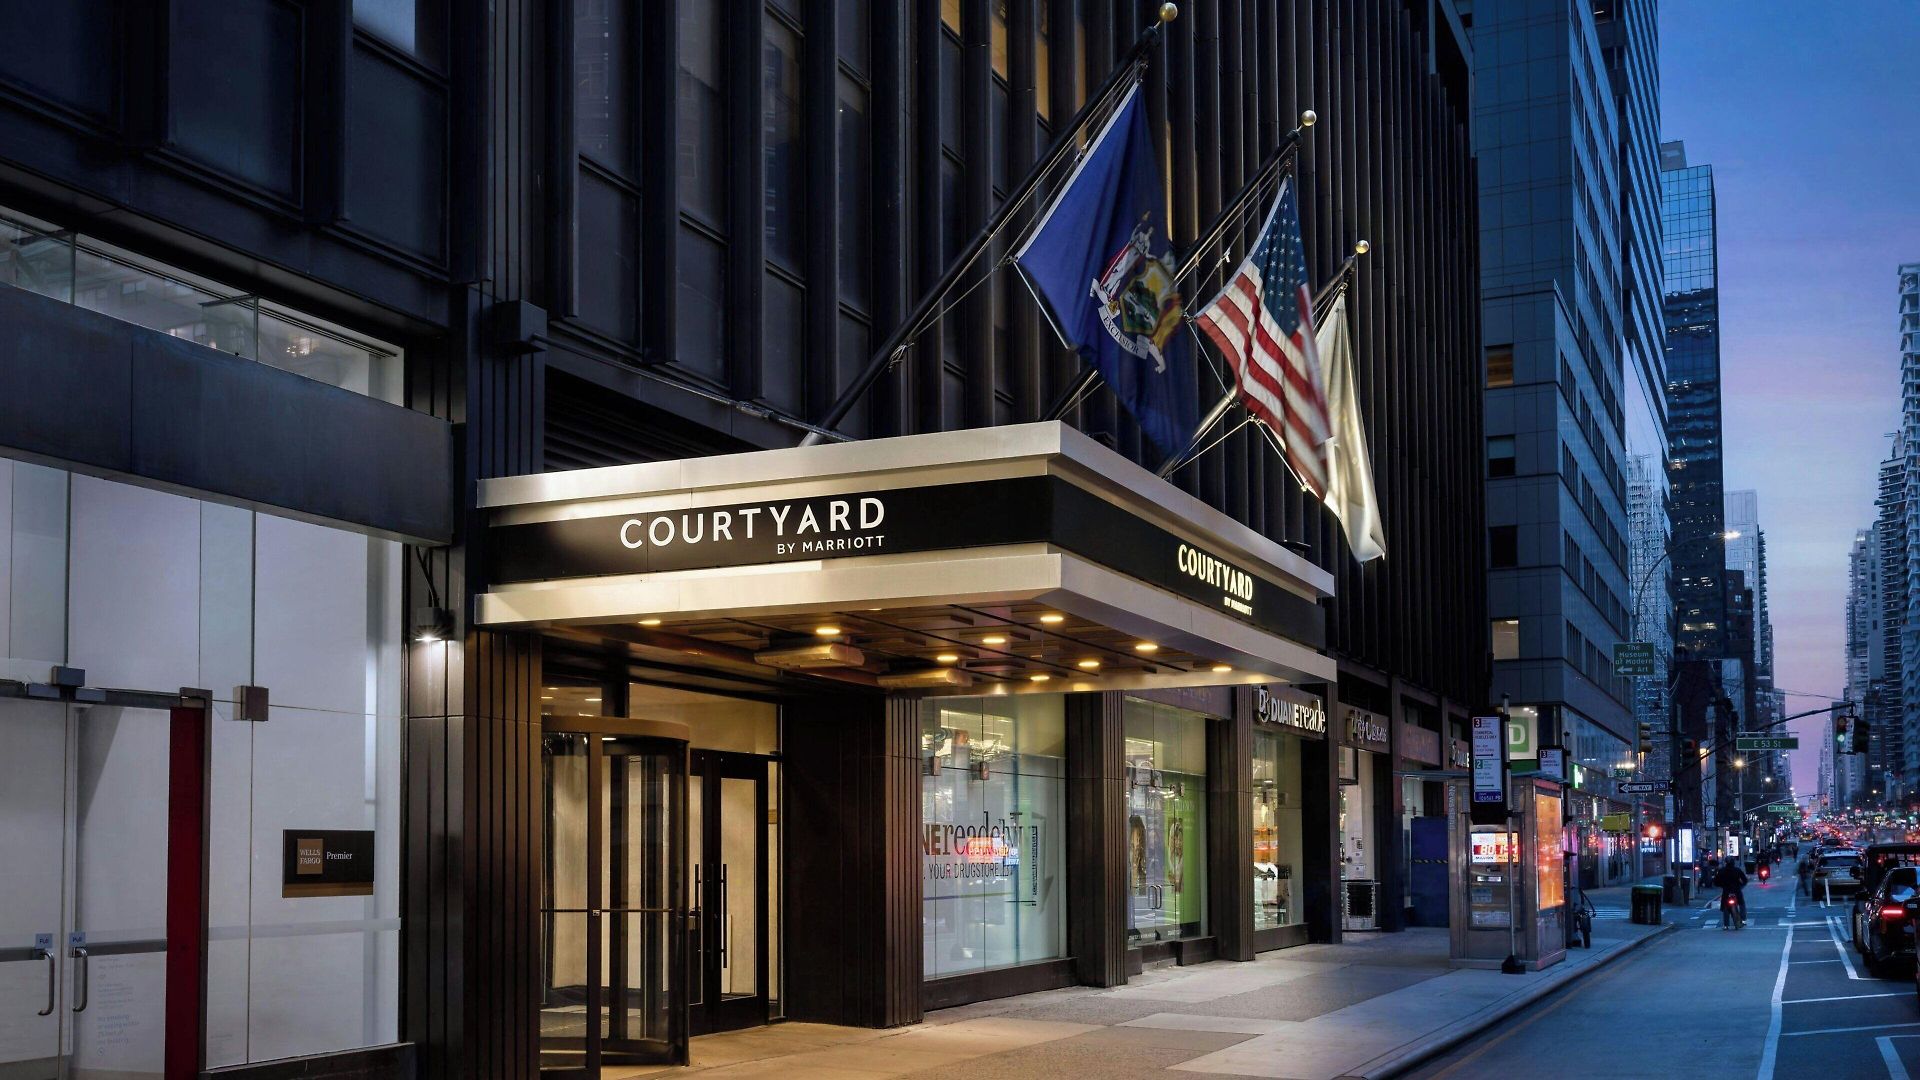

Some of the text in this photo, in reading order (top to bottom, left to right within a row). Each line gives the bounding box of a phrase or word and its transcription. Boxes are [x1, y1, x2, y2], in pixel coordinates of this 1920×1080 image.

[619, 497, 885, 549] COURTYARD
[777, 535, 885, 555] BY MARRIOTT
[1178, 544, 1253, 601] COURTYARD
[1475, 718, 1480, 727] 3
[1773, 740, 1781, 748] St
[1476, 760, 1481, 768] 2
[326, 851, 353, 860] Premier
[300, 857, 321, 865] FARGO
[928, 863, 951, 880] YOUR
